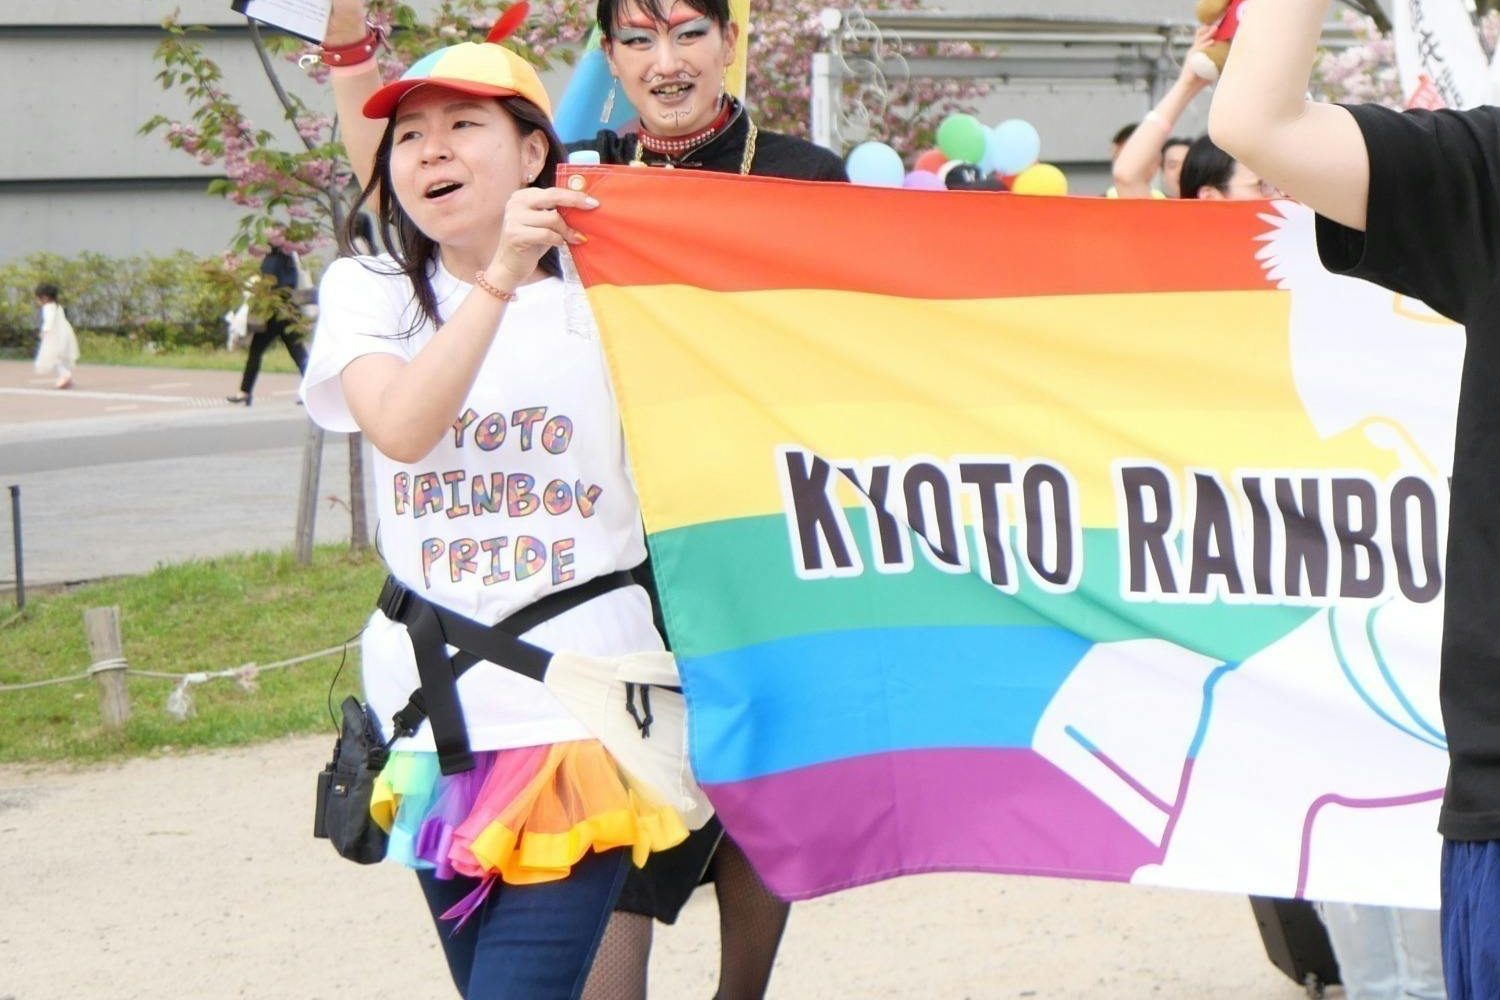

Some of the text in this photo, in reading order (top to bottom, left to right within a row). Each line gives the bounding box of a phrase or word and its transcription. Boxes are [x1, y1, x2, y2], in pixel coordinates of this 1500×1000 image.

[451, 406, 574, 455] YOTO
[782, 449, 1078, 588] KYOTO
[1119, 465, 1452, 604] RAINBO
[421, 535, 576, 590] PRIDE
